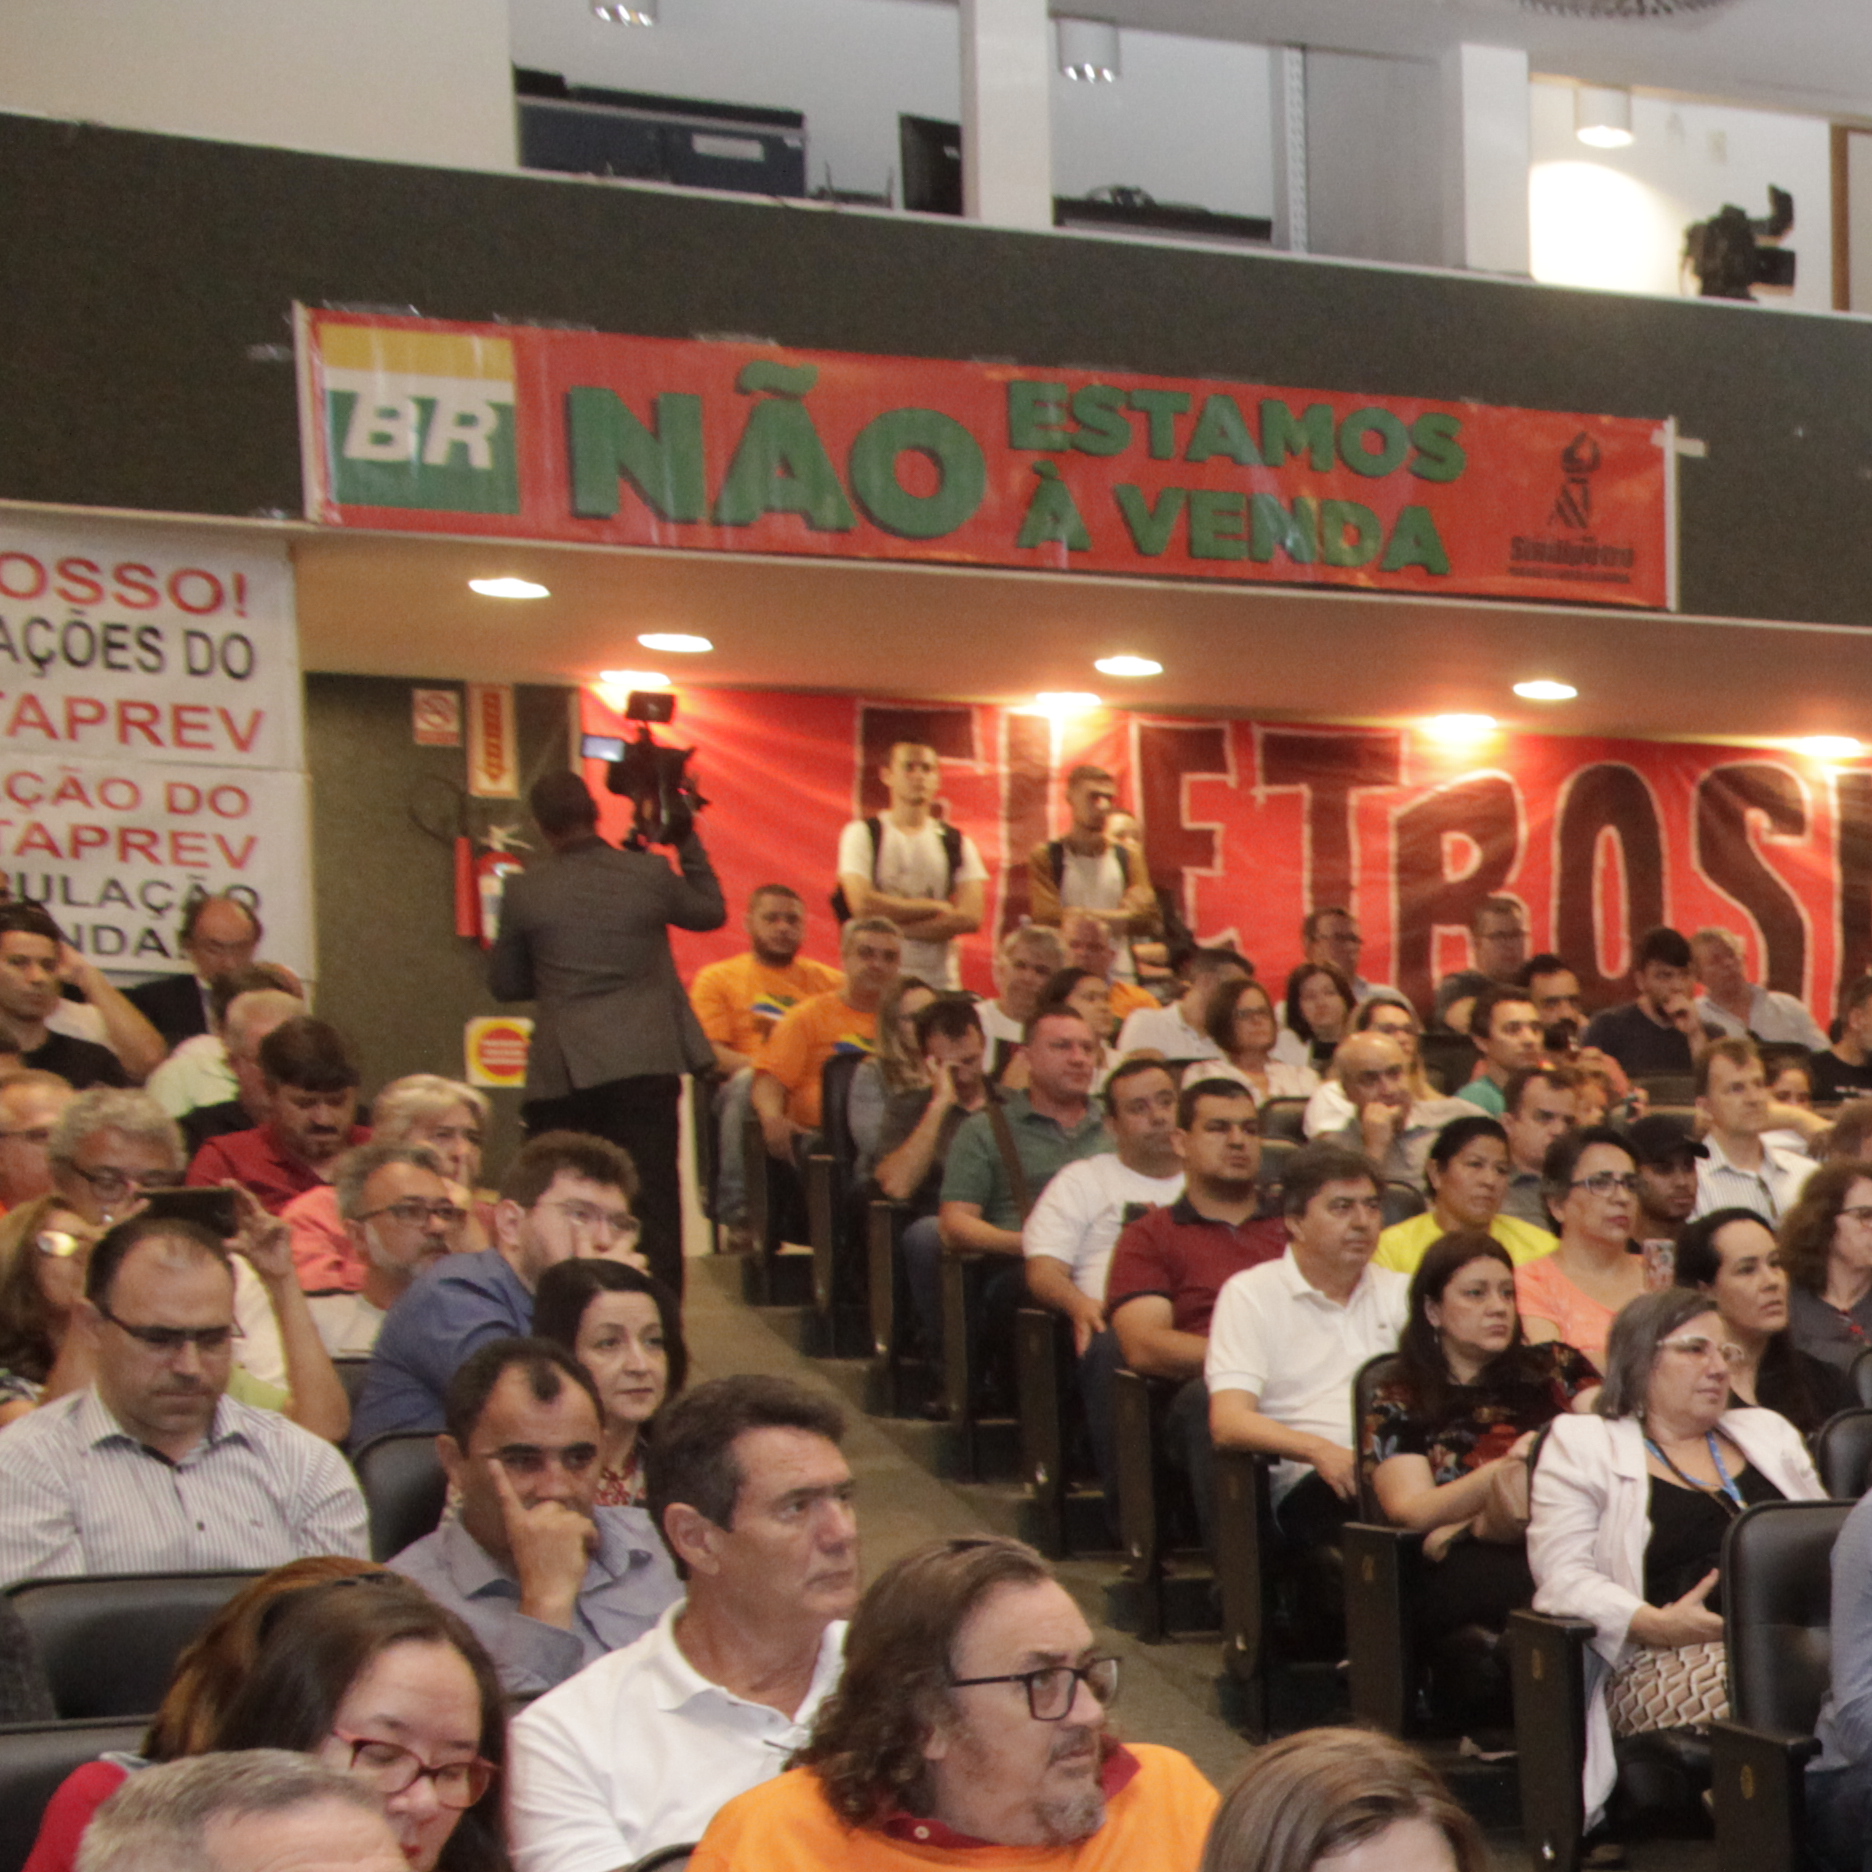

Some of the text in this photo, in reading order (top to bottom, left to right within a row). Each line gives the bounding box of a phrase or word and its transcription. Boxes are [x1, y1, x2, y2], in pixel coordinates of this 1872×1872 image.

[344, 391, 501, 470] BR
[566, 359, 987, 540] NÃO
[1006, 380, 1466, 483] ESTAMOS
[1017, 459, 1451, 575] À VENDA
[0, 550, 249, 618] OSSO!
[183, 629, 257, 682] DO
[0, 691, 265, 753] APREV
[163, 780, 251, 819] DO
